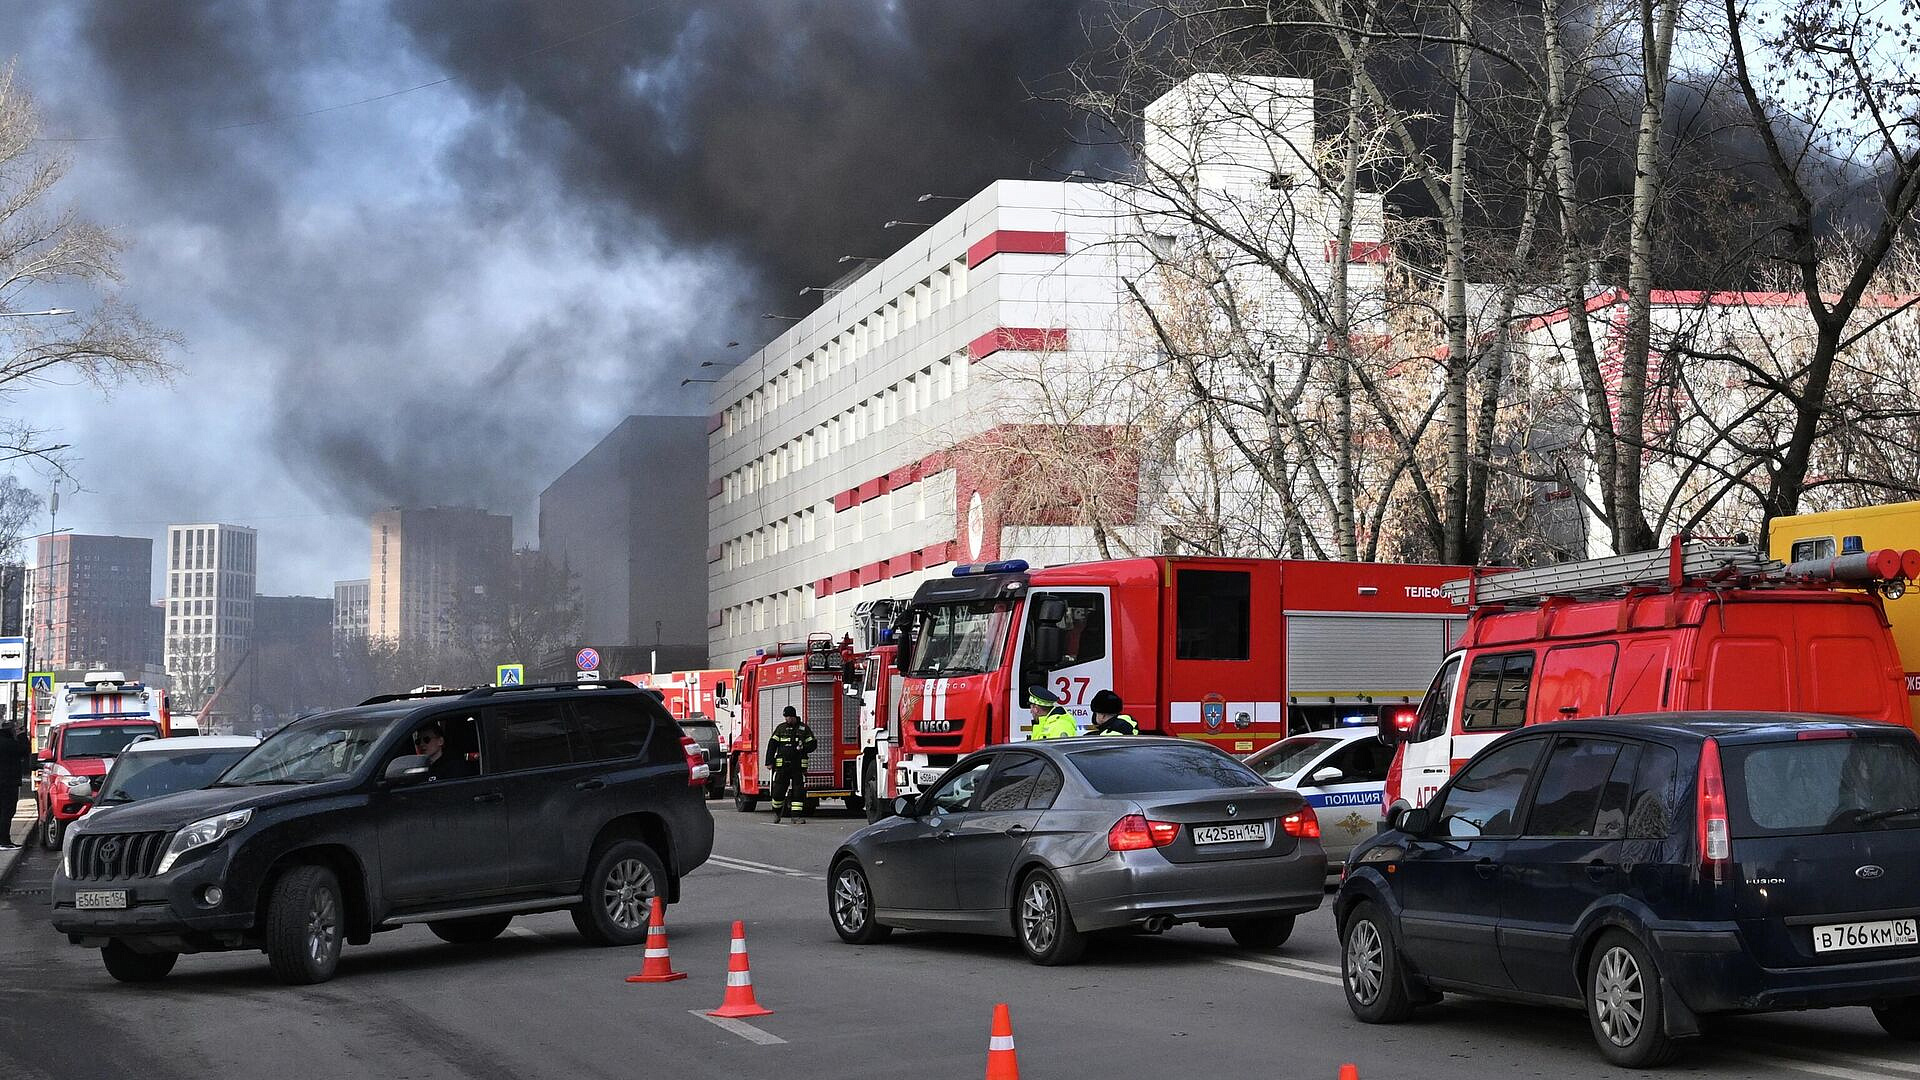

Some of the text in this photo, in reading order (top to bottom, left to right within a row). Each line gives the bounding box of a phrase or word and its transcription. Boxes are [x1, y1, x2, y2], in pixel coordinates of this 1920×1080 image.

[1056, 677, 1091, 705] 37
[920, 720, 950, 732] IVECO
[1325, 792, 1380, 805] ПОЛИЦИЯ
